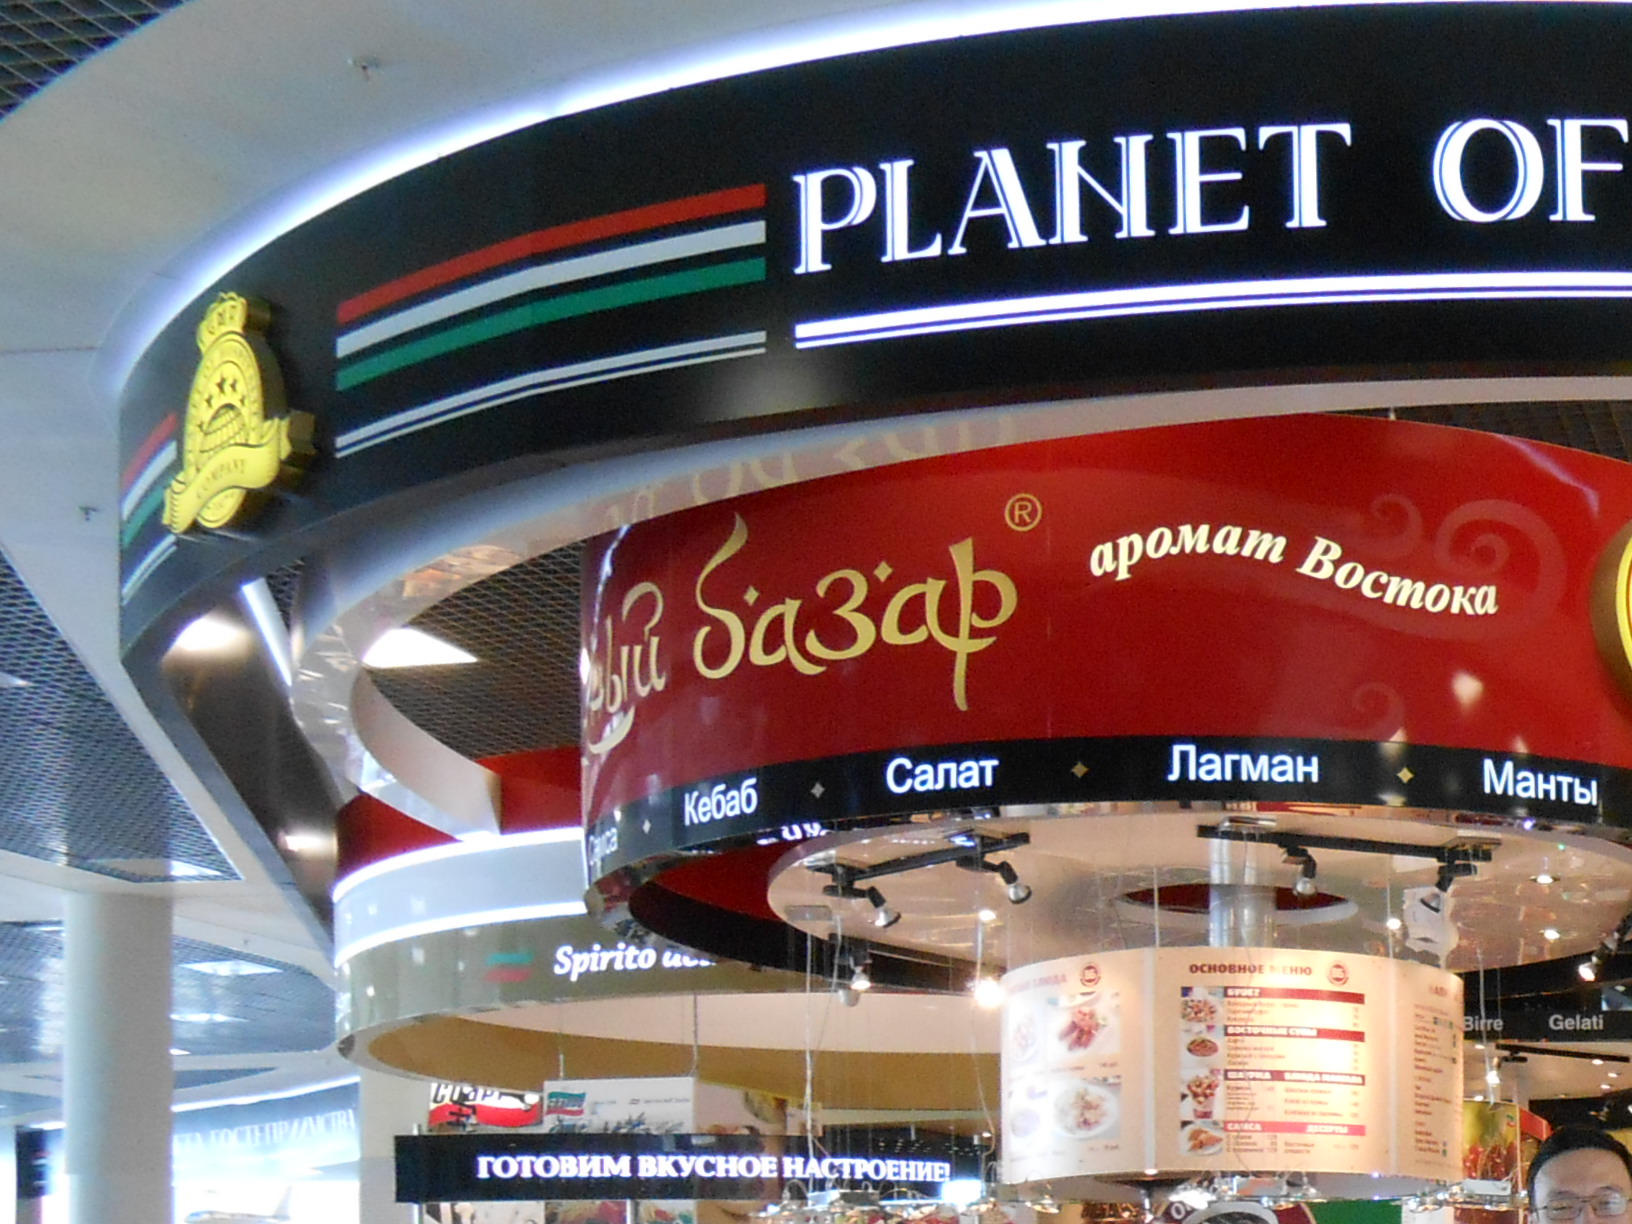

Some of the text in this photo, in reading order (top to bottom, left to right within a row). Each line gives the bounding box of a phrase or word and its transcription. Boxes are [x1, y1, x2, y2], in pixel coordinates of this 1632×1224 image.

[793, 122, 1351, 275] PLANET
[1432, 118, 1629, 223] OF
[1089, 523, 1499, 616] аромат Востока
[694, 511, 1017, 712] базар
[886, 757, 999, 794] Салат
[1167, 743, 1320, 784] Лагман
[1483, 758, 1598, 807] Манты
[684, 777, 758, 826] Кебаб
[553, 943, 657, 981] Spirito
[1189, 963, 1265, 975] ОСНОВНОЕ
[1463, 1015, 1504, 1031] Birre
[1548, 1014, 1604, 1031] Gelati
[476, 1155, 951, 1183] ГОТОВИМ ВКУСНОЕ НАСТРОЕНИЕ!
